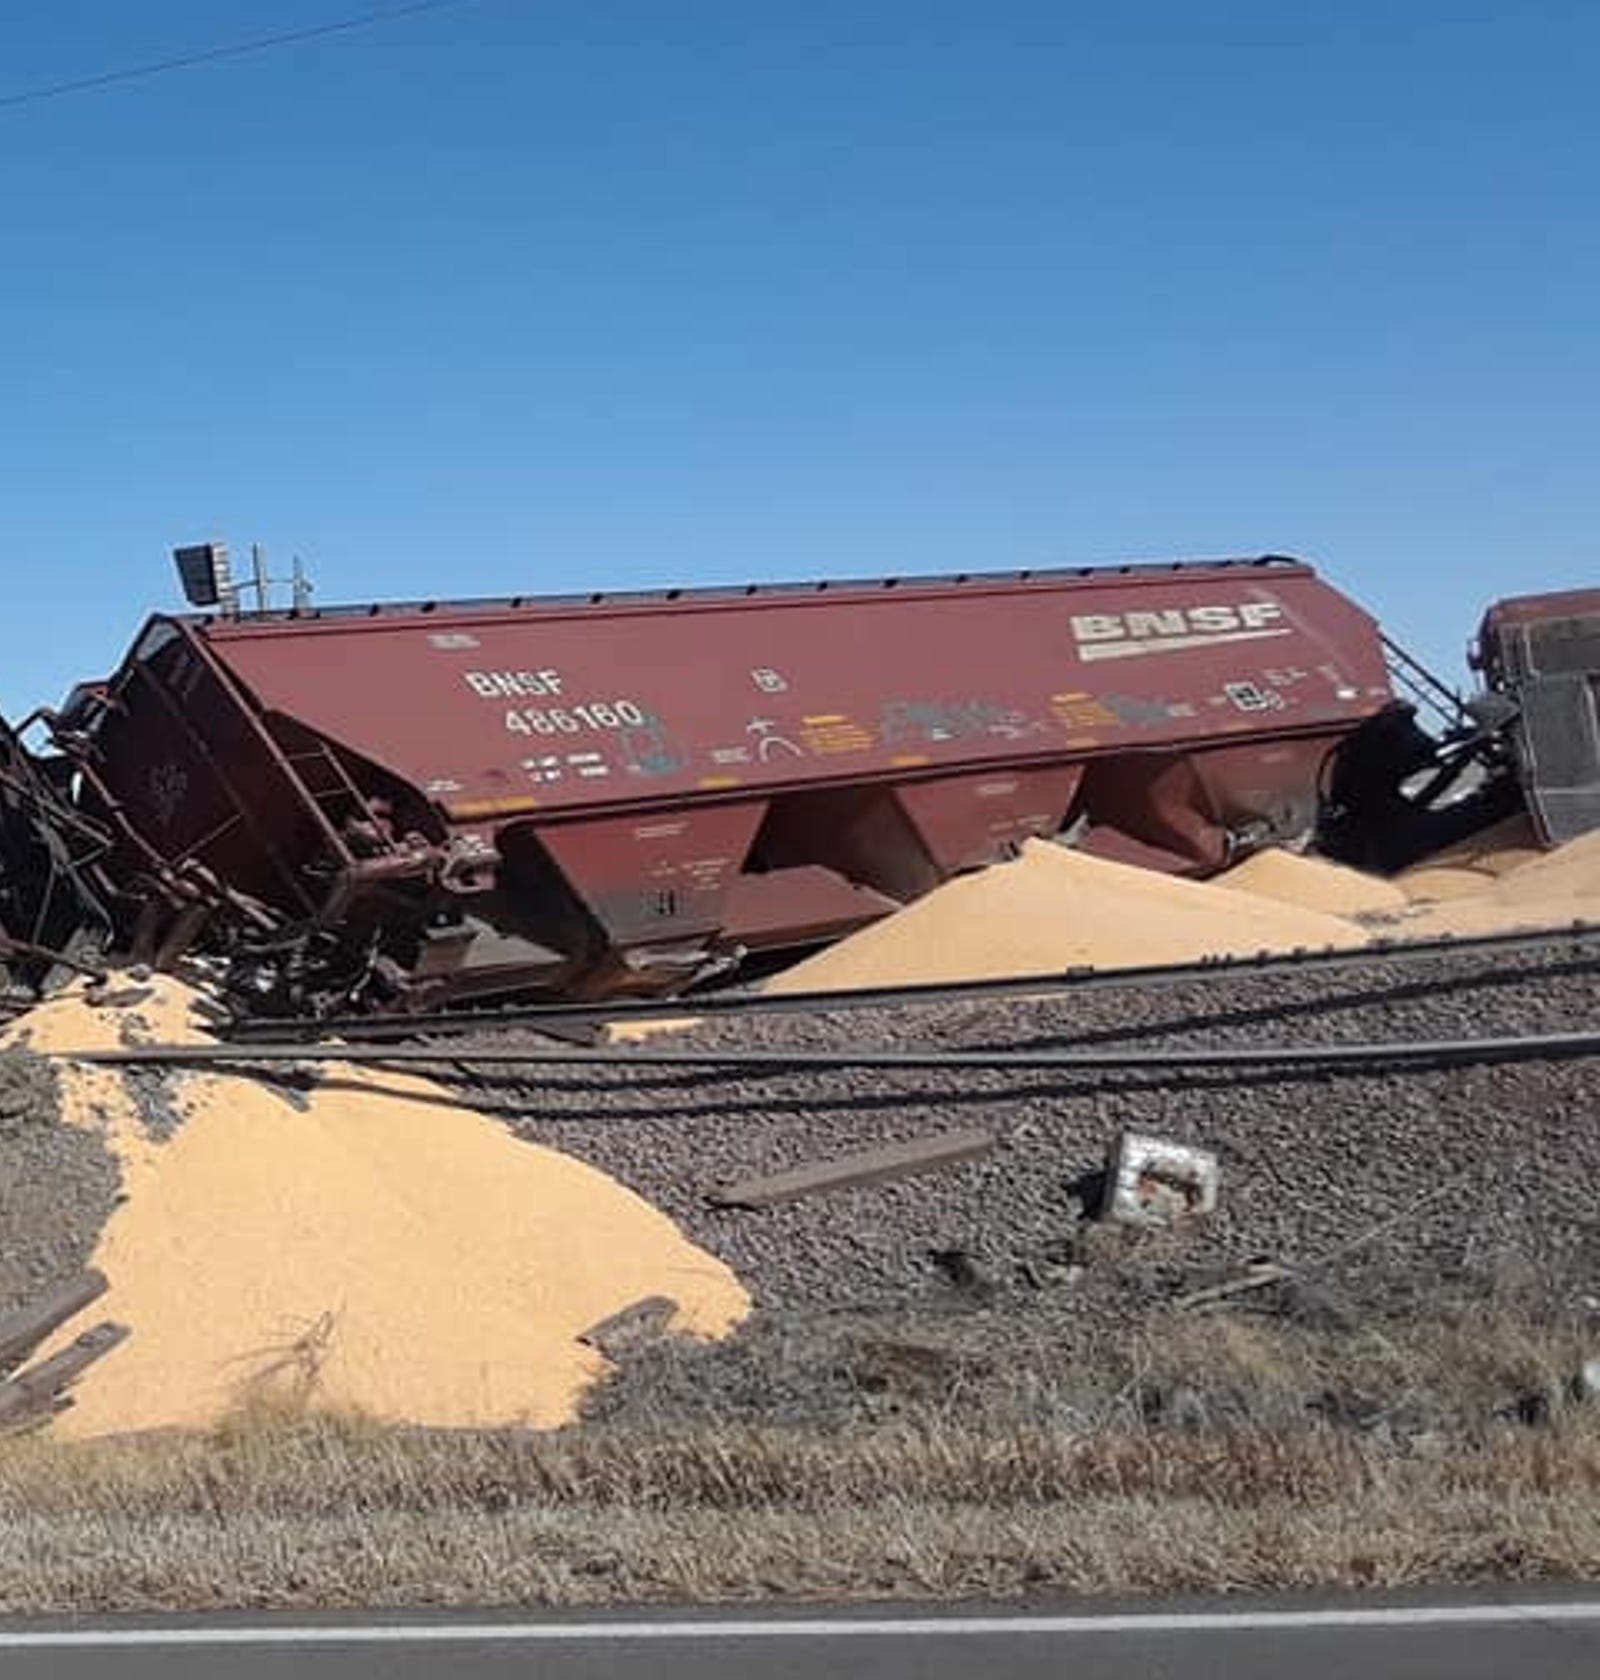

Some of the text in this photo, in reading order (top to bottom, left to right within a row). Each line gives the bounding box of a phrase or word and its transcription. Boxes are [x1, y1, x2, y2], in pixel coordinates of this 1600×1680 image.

[1070, 602, 1281, 641] BNSF
[465, 669, 562, 697] BNSF
[505, 700, 643, 735] 486160
